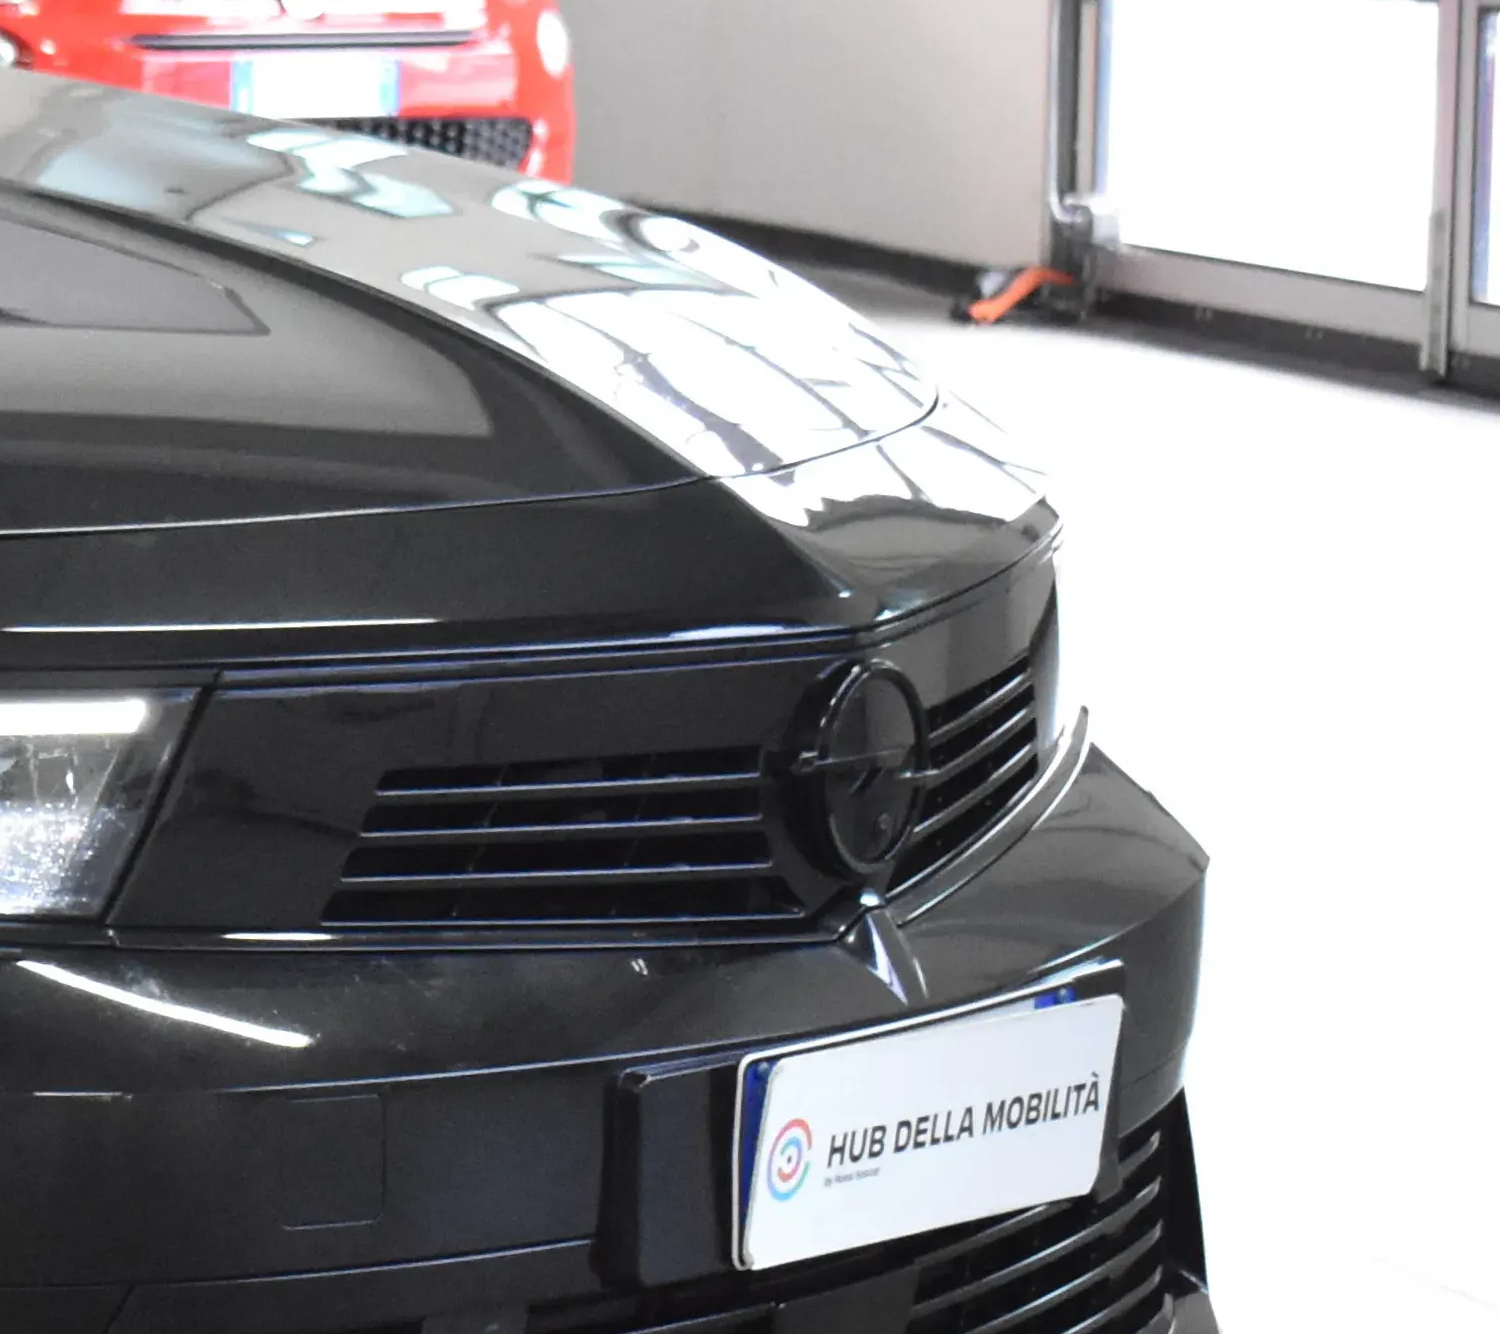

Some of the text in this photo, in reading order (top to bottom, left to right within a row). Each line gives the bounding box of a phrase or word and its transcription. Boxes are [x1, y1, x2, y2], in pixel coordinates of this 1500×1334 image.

[827, 1072, 1100, 1167] HUB DELLA MOBILITÀ
